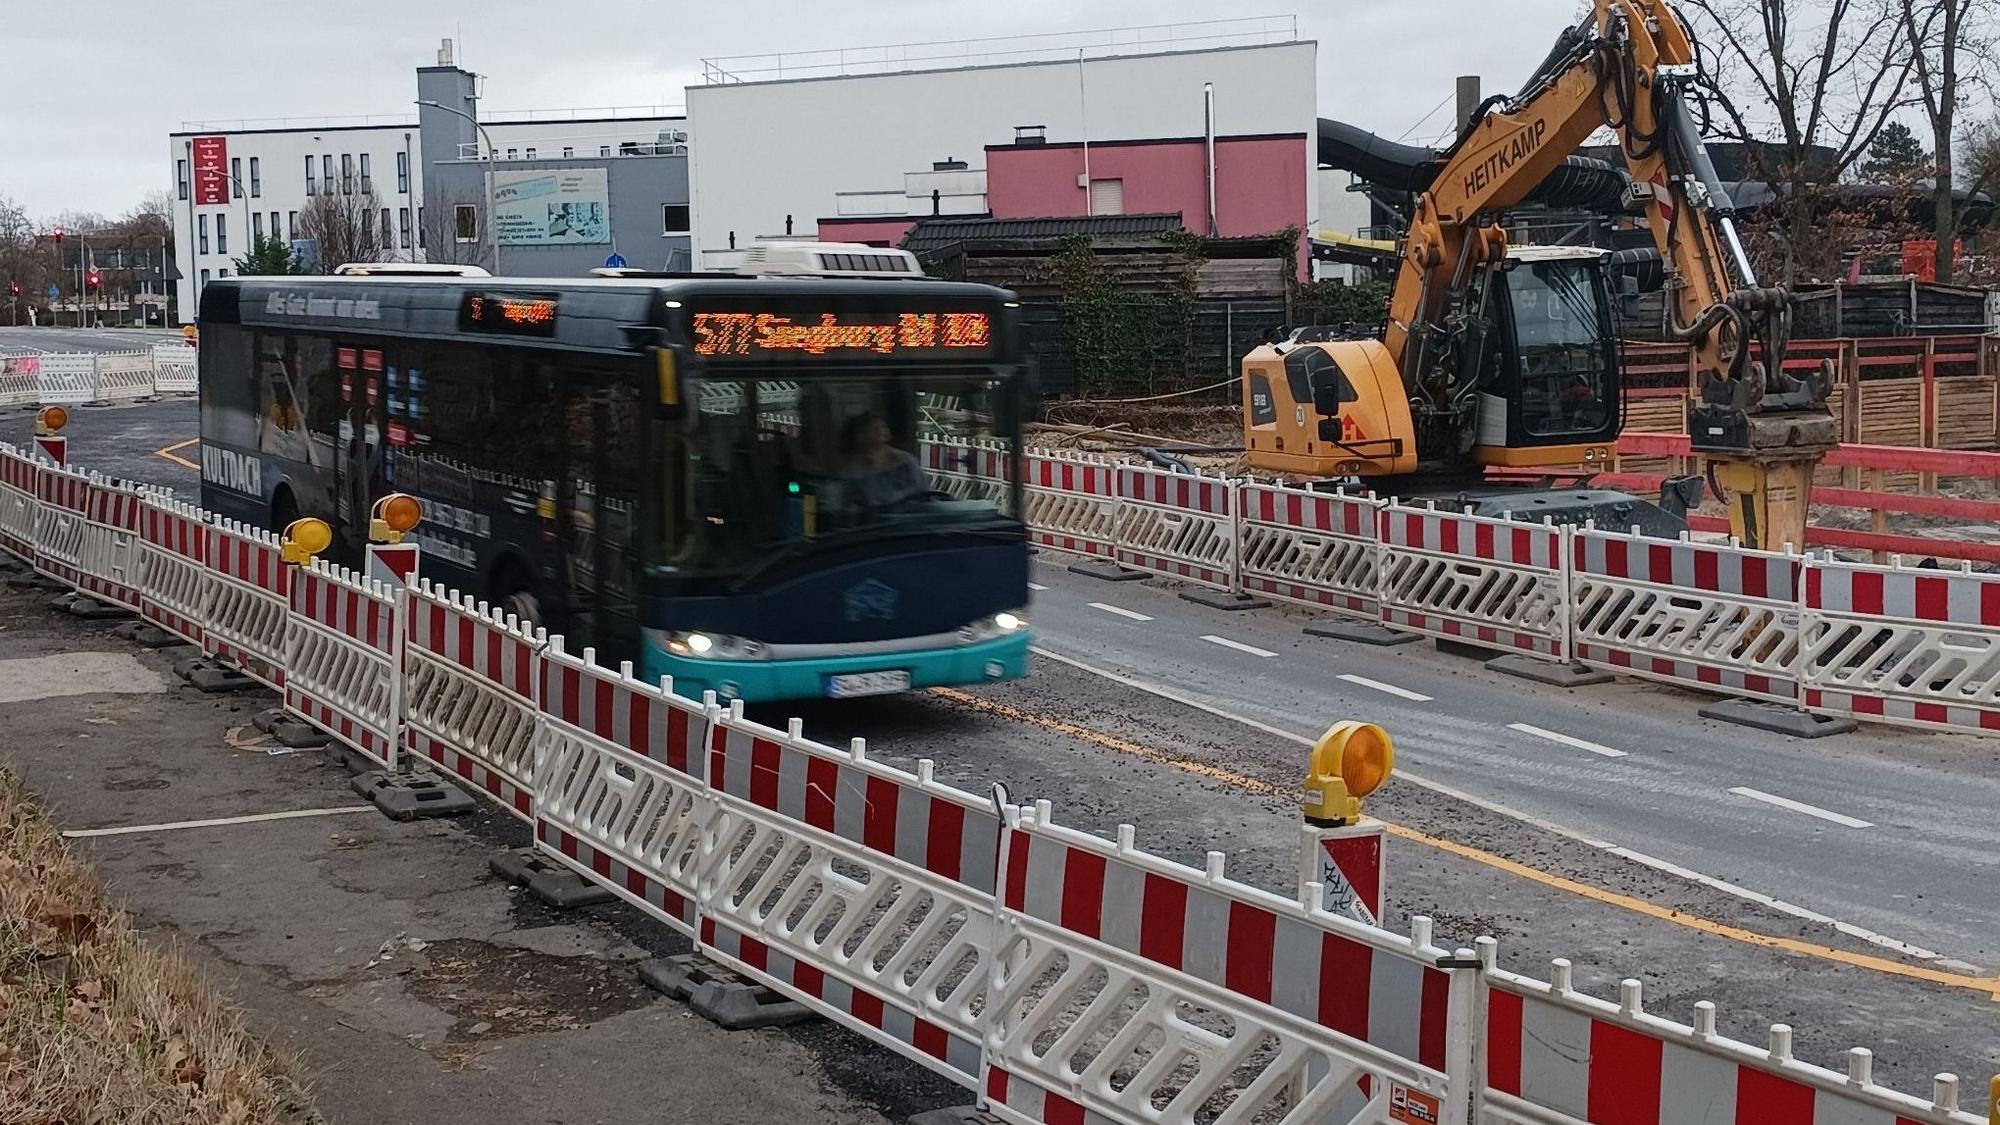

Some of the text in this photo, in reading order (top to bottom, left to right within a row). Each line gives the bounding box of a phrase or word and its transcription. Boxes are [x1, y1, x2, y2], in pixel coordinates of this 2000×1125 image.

[1463, 118, 1546, 199] HEITKAMP
[692, 312, 754, 355] 577
[202, 444, 262, 498] KULTDACH
